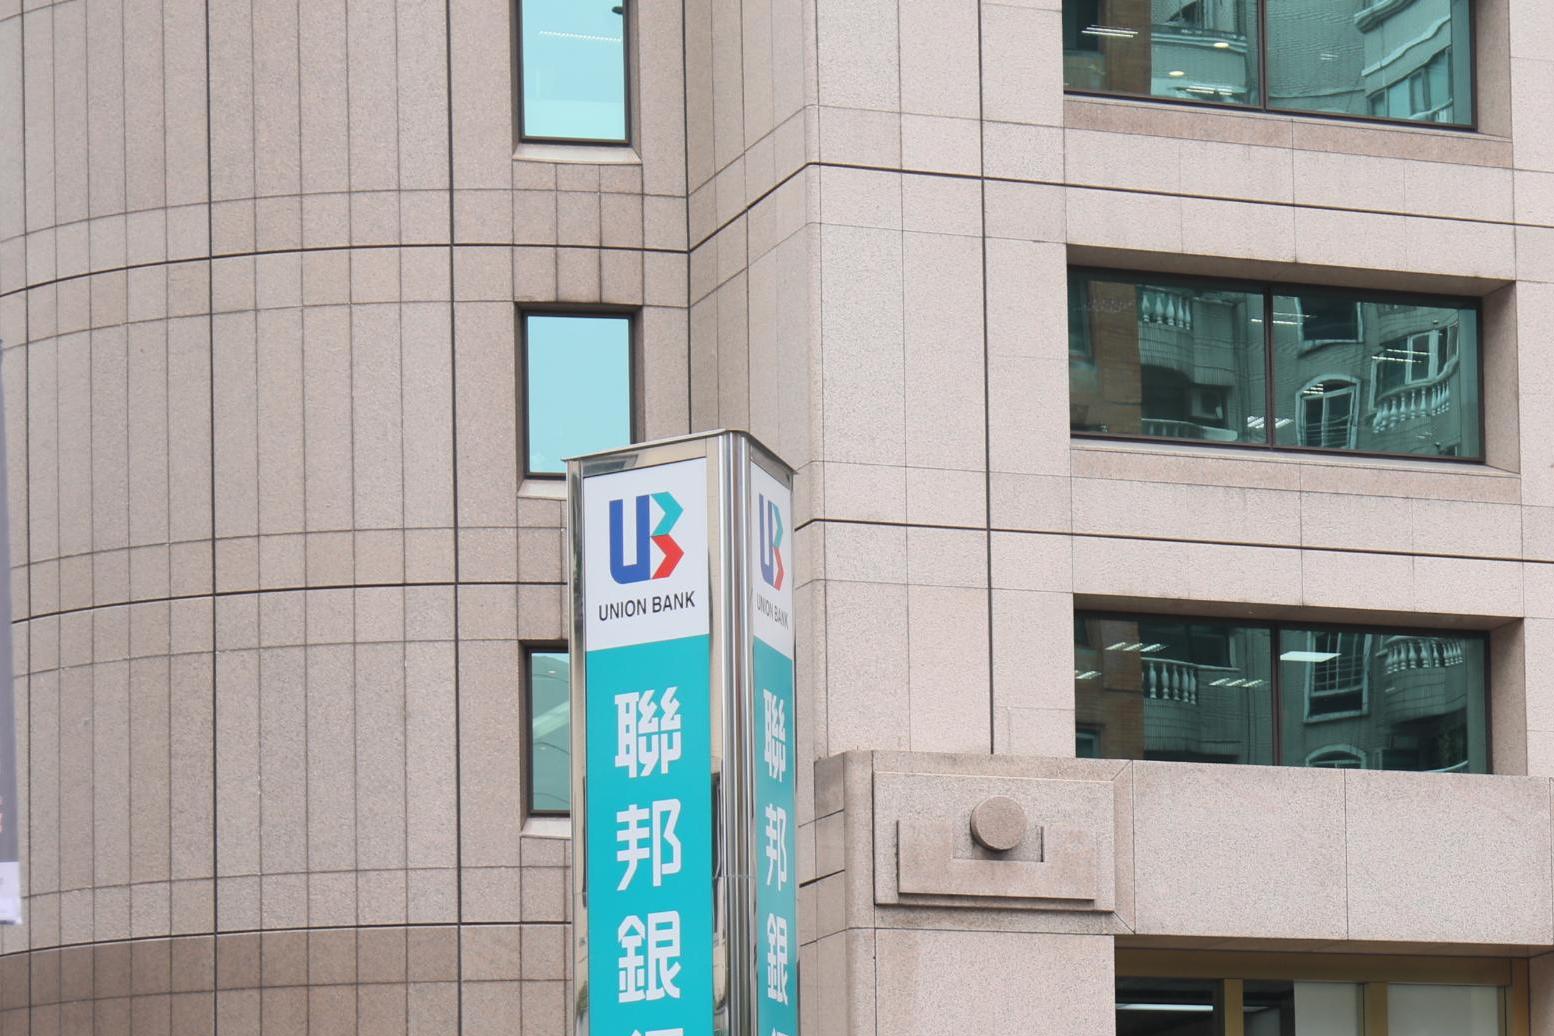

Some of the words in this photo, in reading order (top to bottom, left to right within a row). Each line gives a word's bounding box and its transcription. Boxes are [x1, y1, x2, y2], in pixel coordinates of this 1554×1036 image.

[598, 596, 648, 622] UNION
[652, 590, 696, 613] BANK
[757, 594, 774, 622] UNION
[774, 605, 789, 630] BANK
